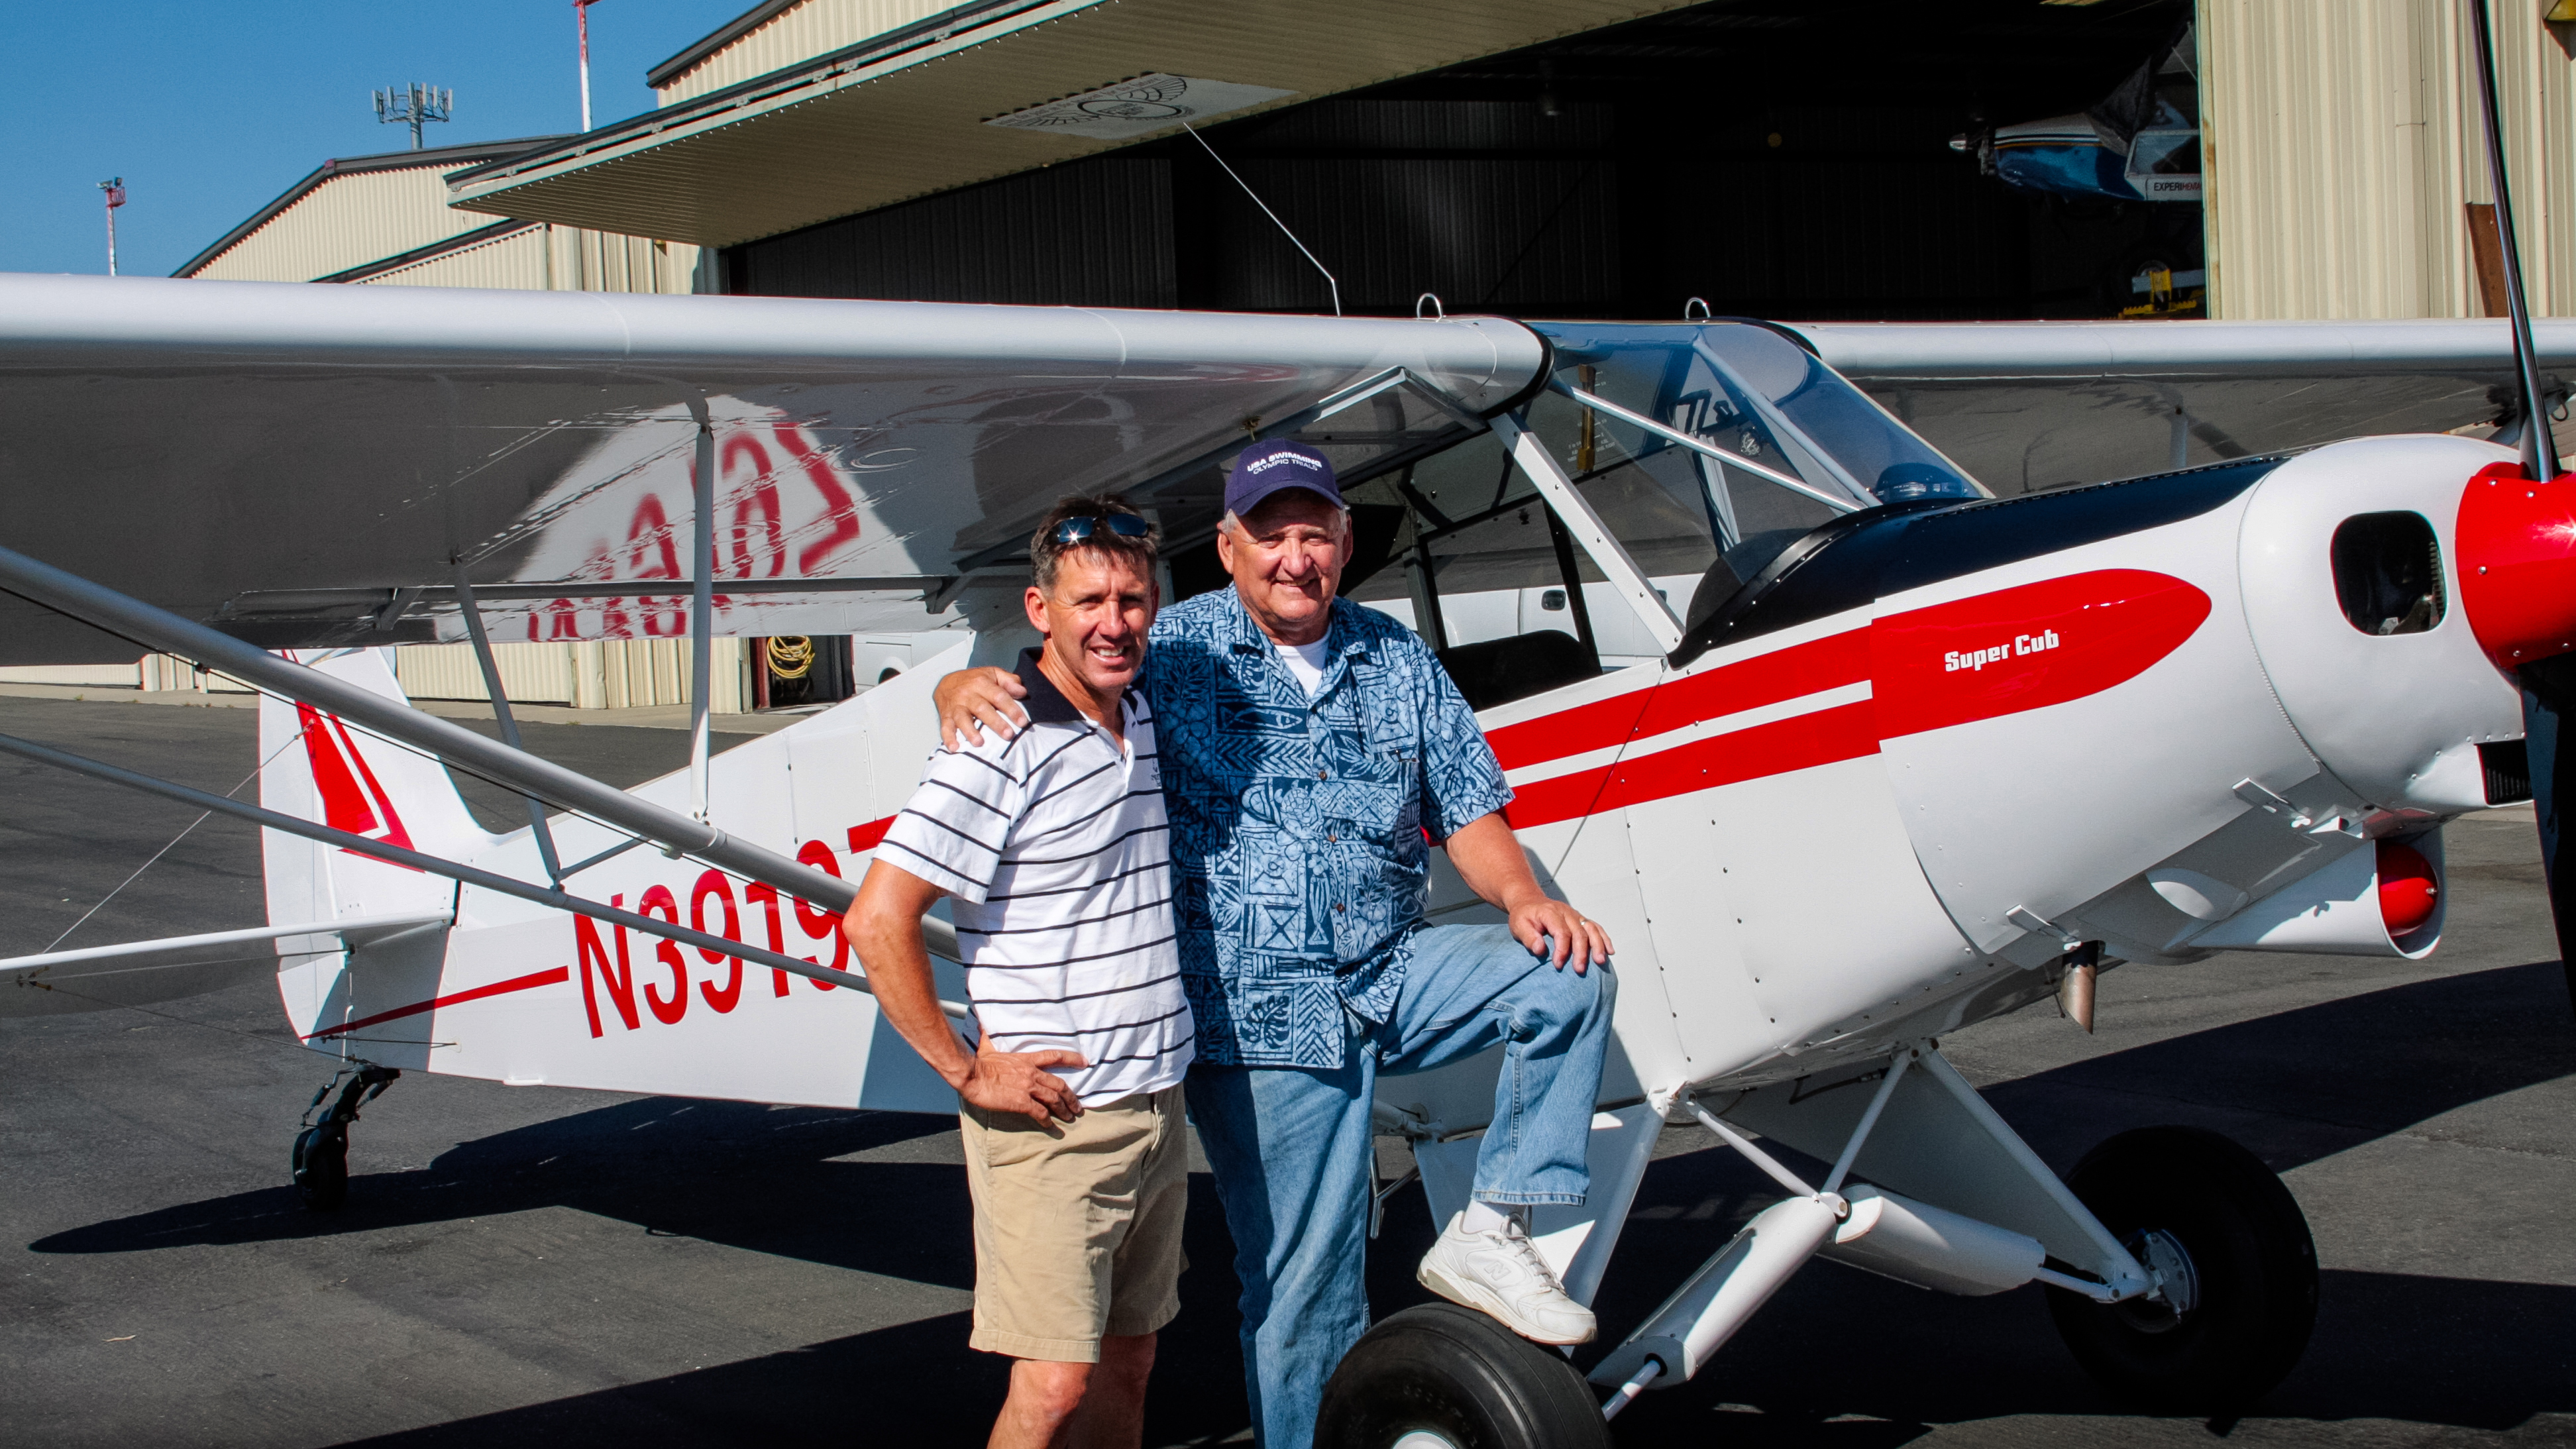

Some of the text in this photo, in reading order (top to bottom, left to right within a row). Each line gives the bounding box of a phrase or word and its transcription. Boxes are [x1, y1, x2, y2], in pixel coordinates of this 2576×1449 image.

[1247, 452, 1322, 472] USA SWIMMING
[1253, 458, 1318, 474] OLYMPIC TRIALS
[1945, 629, 2059, 672] Super Cub
[574, 815, 899, 1039] N3919
